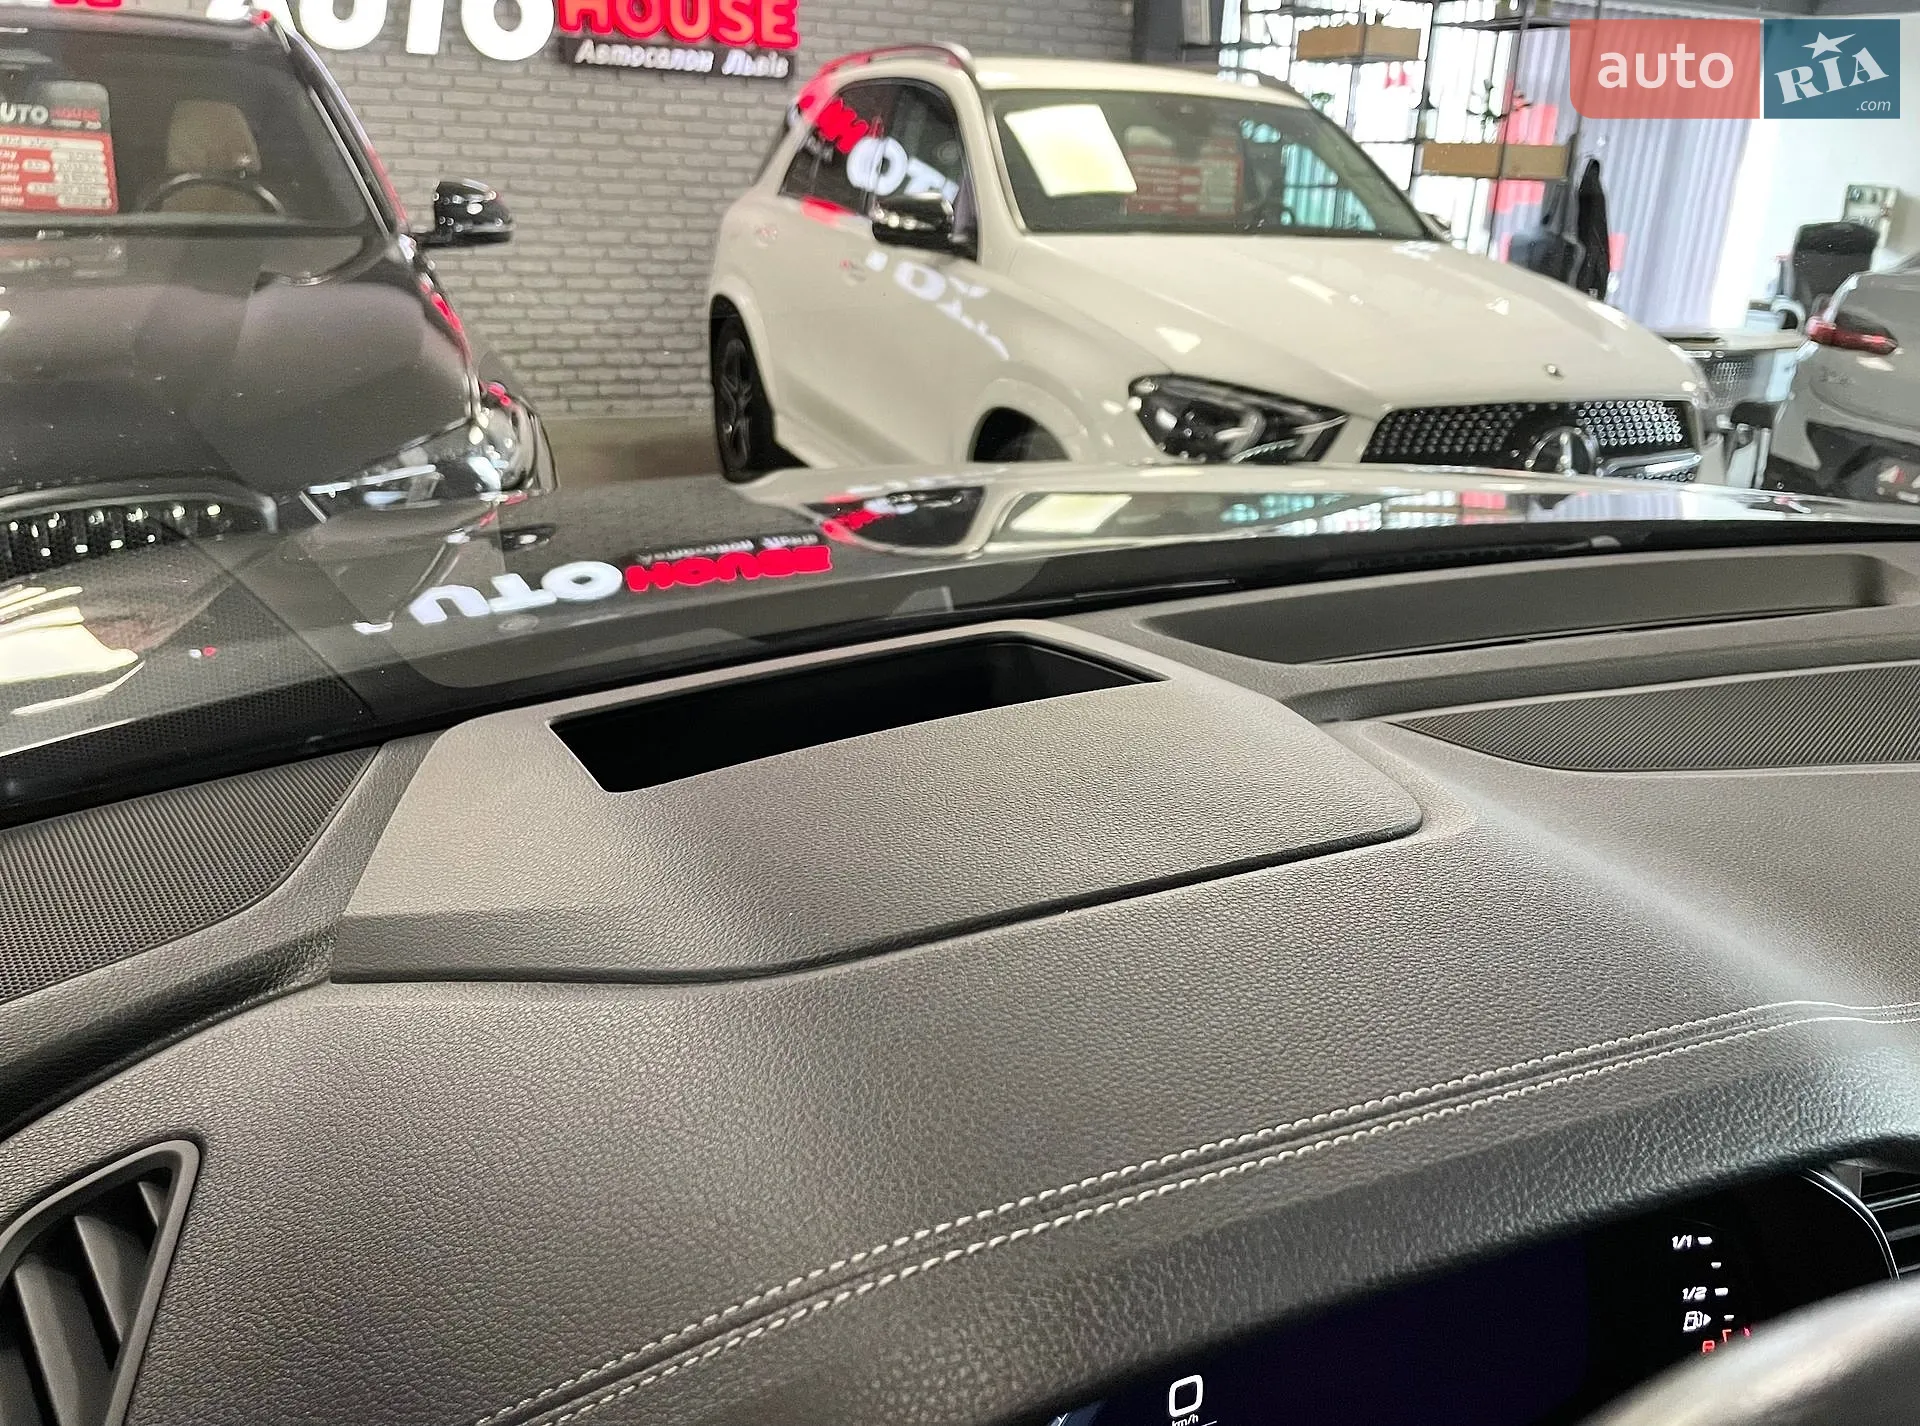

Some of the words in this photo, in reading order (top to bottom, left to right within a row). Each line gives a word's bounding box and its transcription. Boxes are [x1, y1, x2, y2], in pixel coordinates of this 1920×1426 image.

[1672, 1235, 1692, 1249] 1/1
[1682, 1287, 1707, 1301] 1/2
[1169, 1375, 1203, 1417] 0
[1172, 1414, 1199, 1426] km/h
